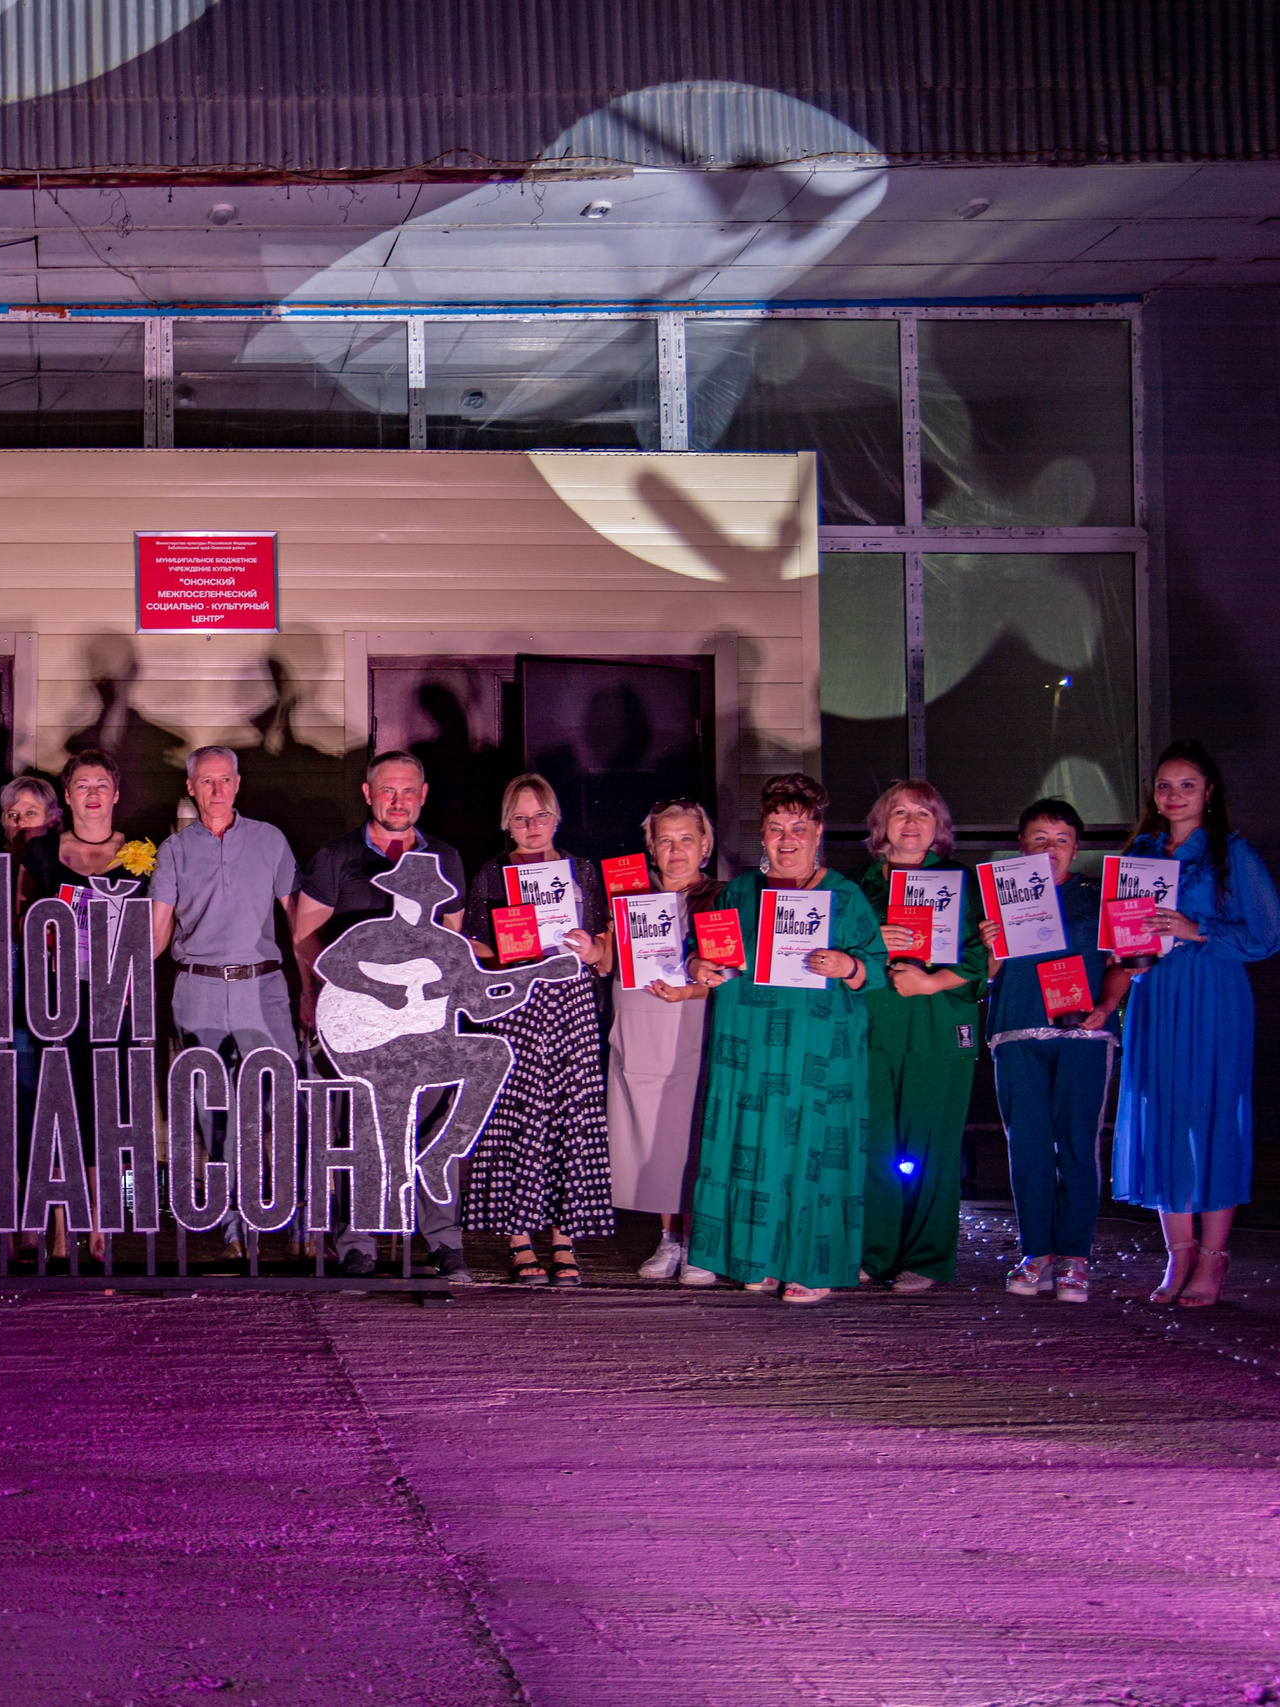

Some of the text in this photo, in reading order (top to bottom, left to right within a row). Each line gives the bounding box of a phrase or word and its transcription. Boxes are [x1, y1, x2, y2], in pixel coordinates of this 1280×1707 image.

[157, 589, 257, 598] МЕЖПОСЕЛЕНЧЕСКИЙ
[146, 602, 204, 611] СОЦИАЛЬНО
[211, 601, 269, 610] КУЛЬТУРНЫЙ
[521, 880, 540, 894] Мой
[996, 877, 1017, 892] Мой
[1120, 873, 1139, 888] Мой
[906, 886, 924, 899] Мой
[629, 912, 647, 925] Мой
[777, 906, 795, 921] Мой
[631, 923, 667, 939] ШАНСОН
[775, 920, 813, 935] ШАНСОН
